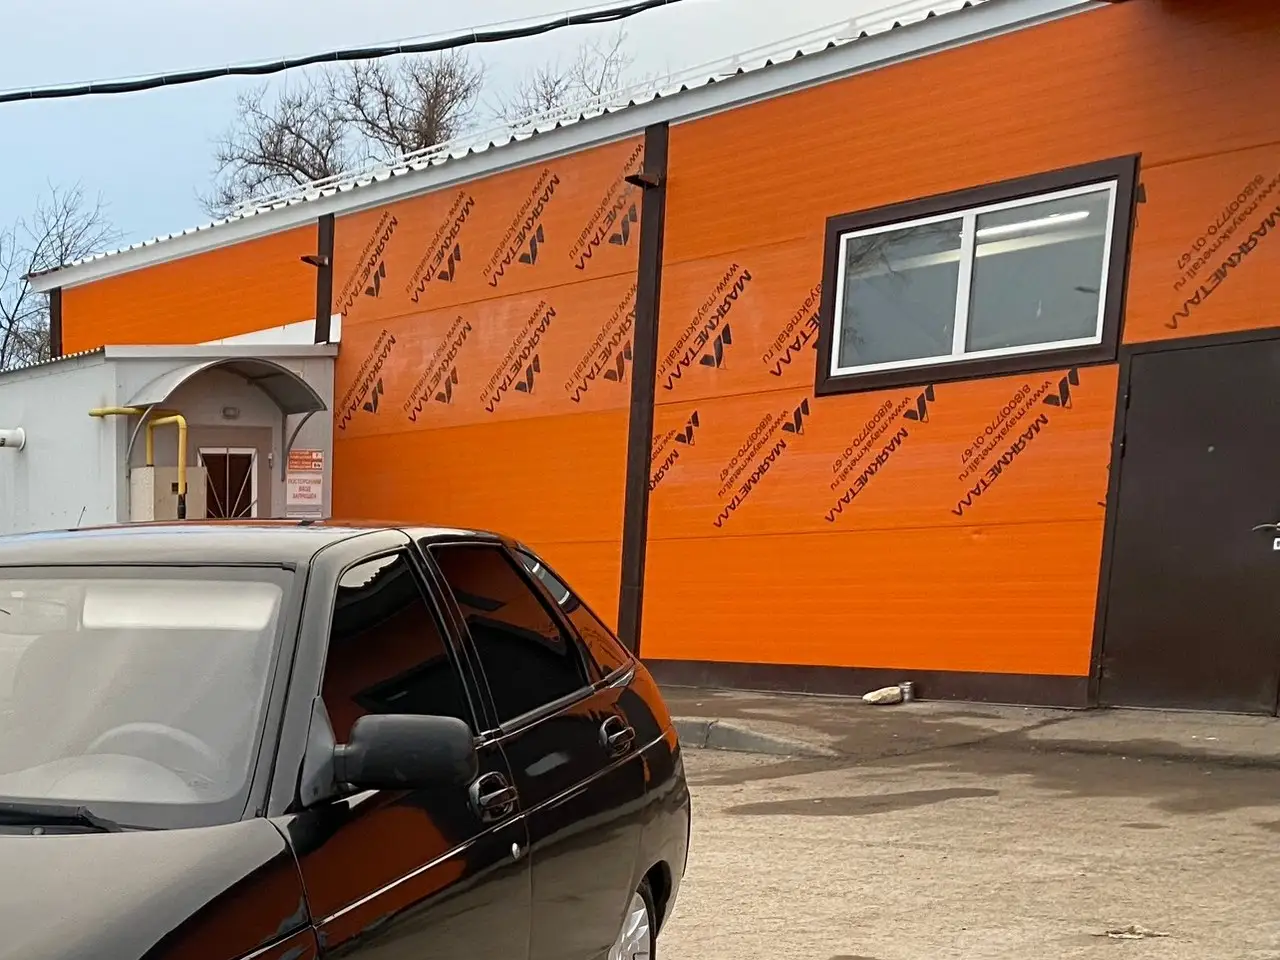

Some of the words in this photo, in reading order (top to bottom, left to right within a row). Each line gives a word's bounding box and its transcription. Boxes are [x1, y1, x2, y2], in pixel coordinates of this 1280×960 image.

[570, 304, 638, 403] АЯКМЕТАЛЛ
[720, 413, 773, 481] 8(800)770-01-67
[832, 400, 893, 473] 8(800)770-01-67
[951, 413, 1048, 516] МАЯКМЕТАЛЛ
[961, 384, 1031, 464] 8(800)770-01-67
[713, 438, 787, 528] МАЯКМЕТАЛЛ
[825, 427, 908, 522] МАЯКМЕТАЛЛ
